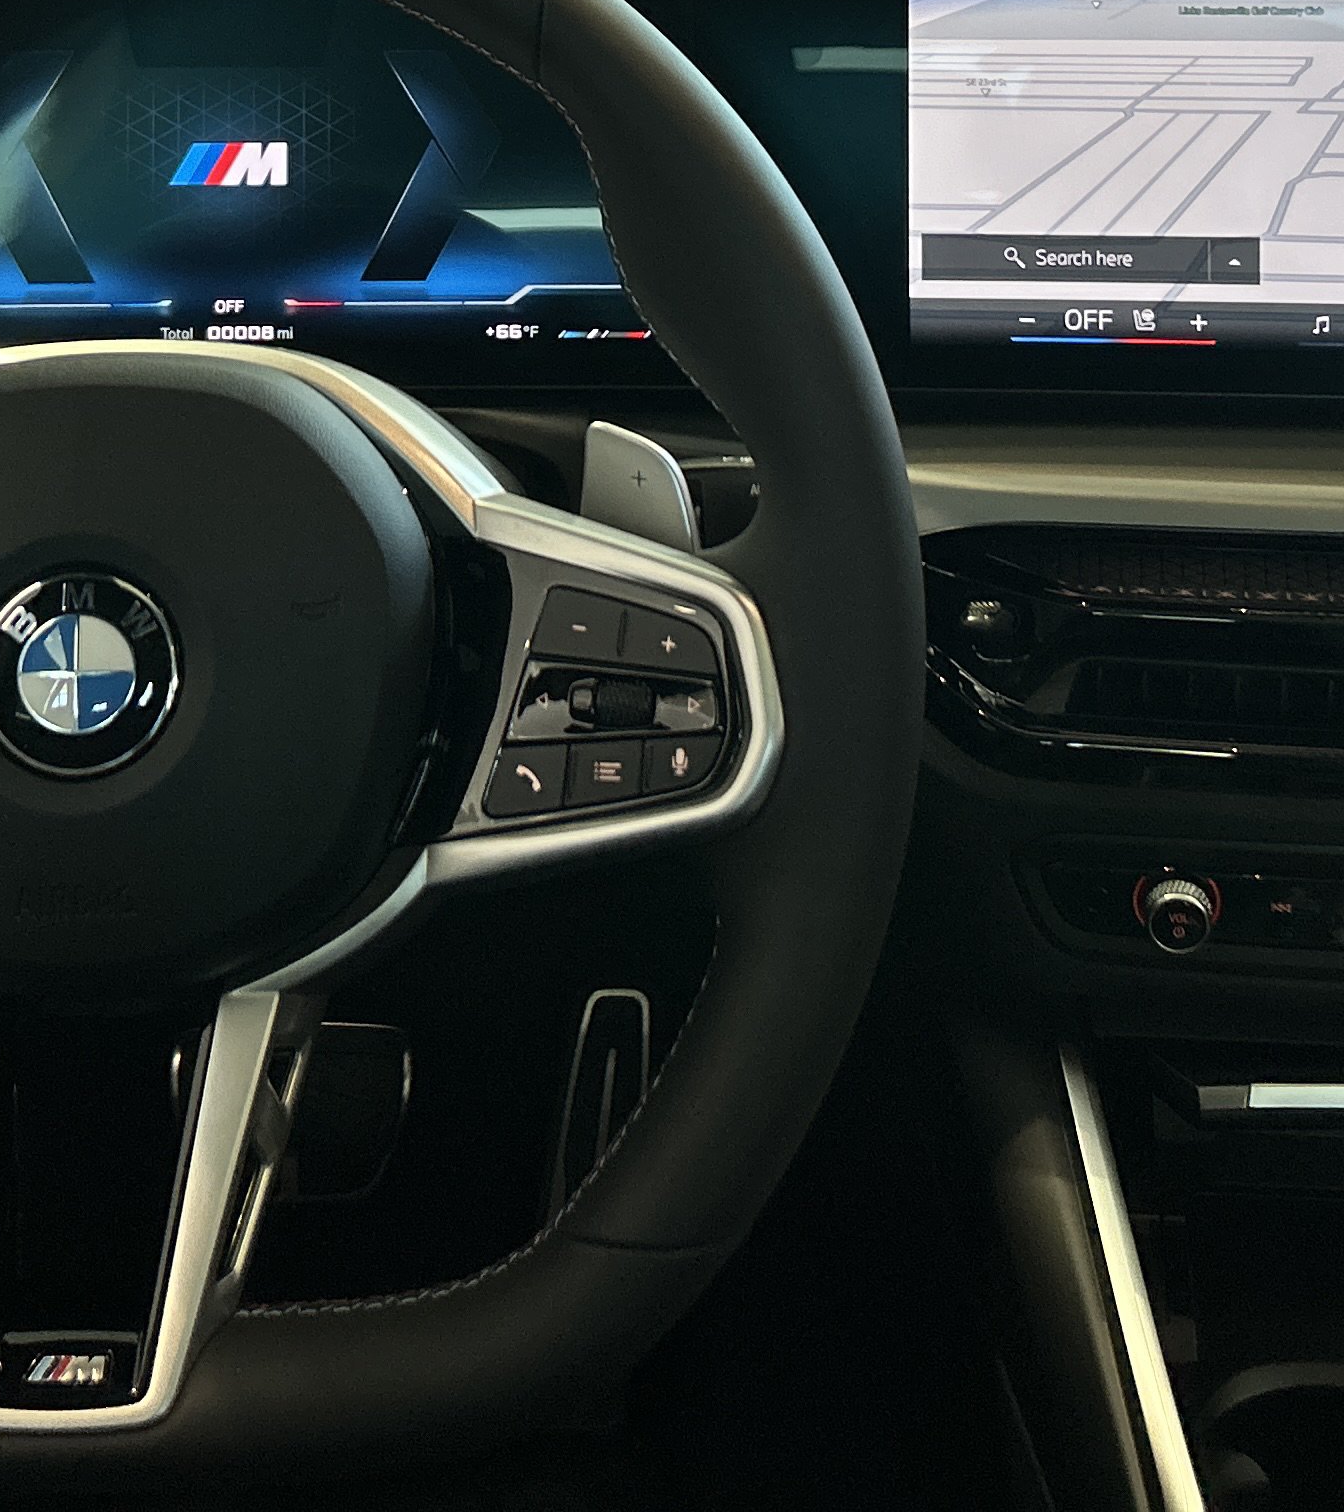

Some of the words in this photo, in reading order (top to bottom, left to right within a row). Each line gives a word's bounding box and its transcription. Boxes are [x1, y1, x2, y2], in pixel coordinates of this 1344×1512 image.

[1034, 248, 1091, 267] Search
[1095, 249, 1134, 268] here
[213, 299, 246, 315] OFF
[1063, 308, 1114, 332] OFF
[159, 325, 194, 341] Total
[206, 325, 275, 341] 00008
[277, 326, 294, 341] mi
